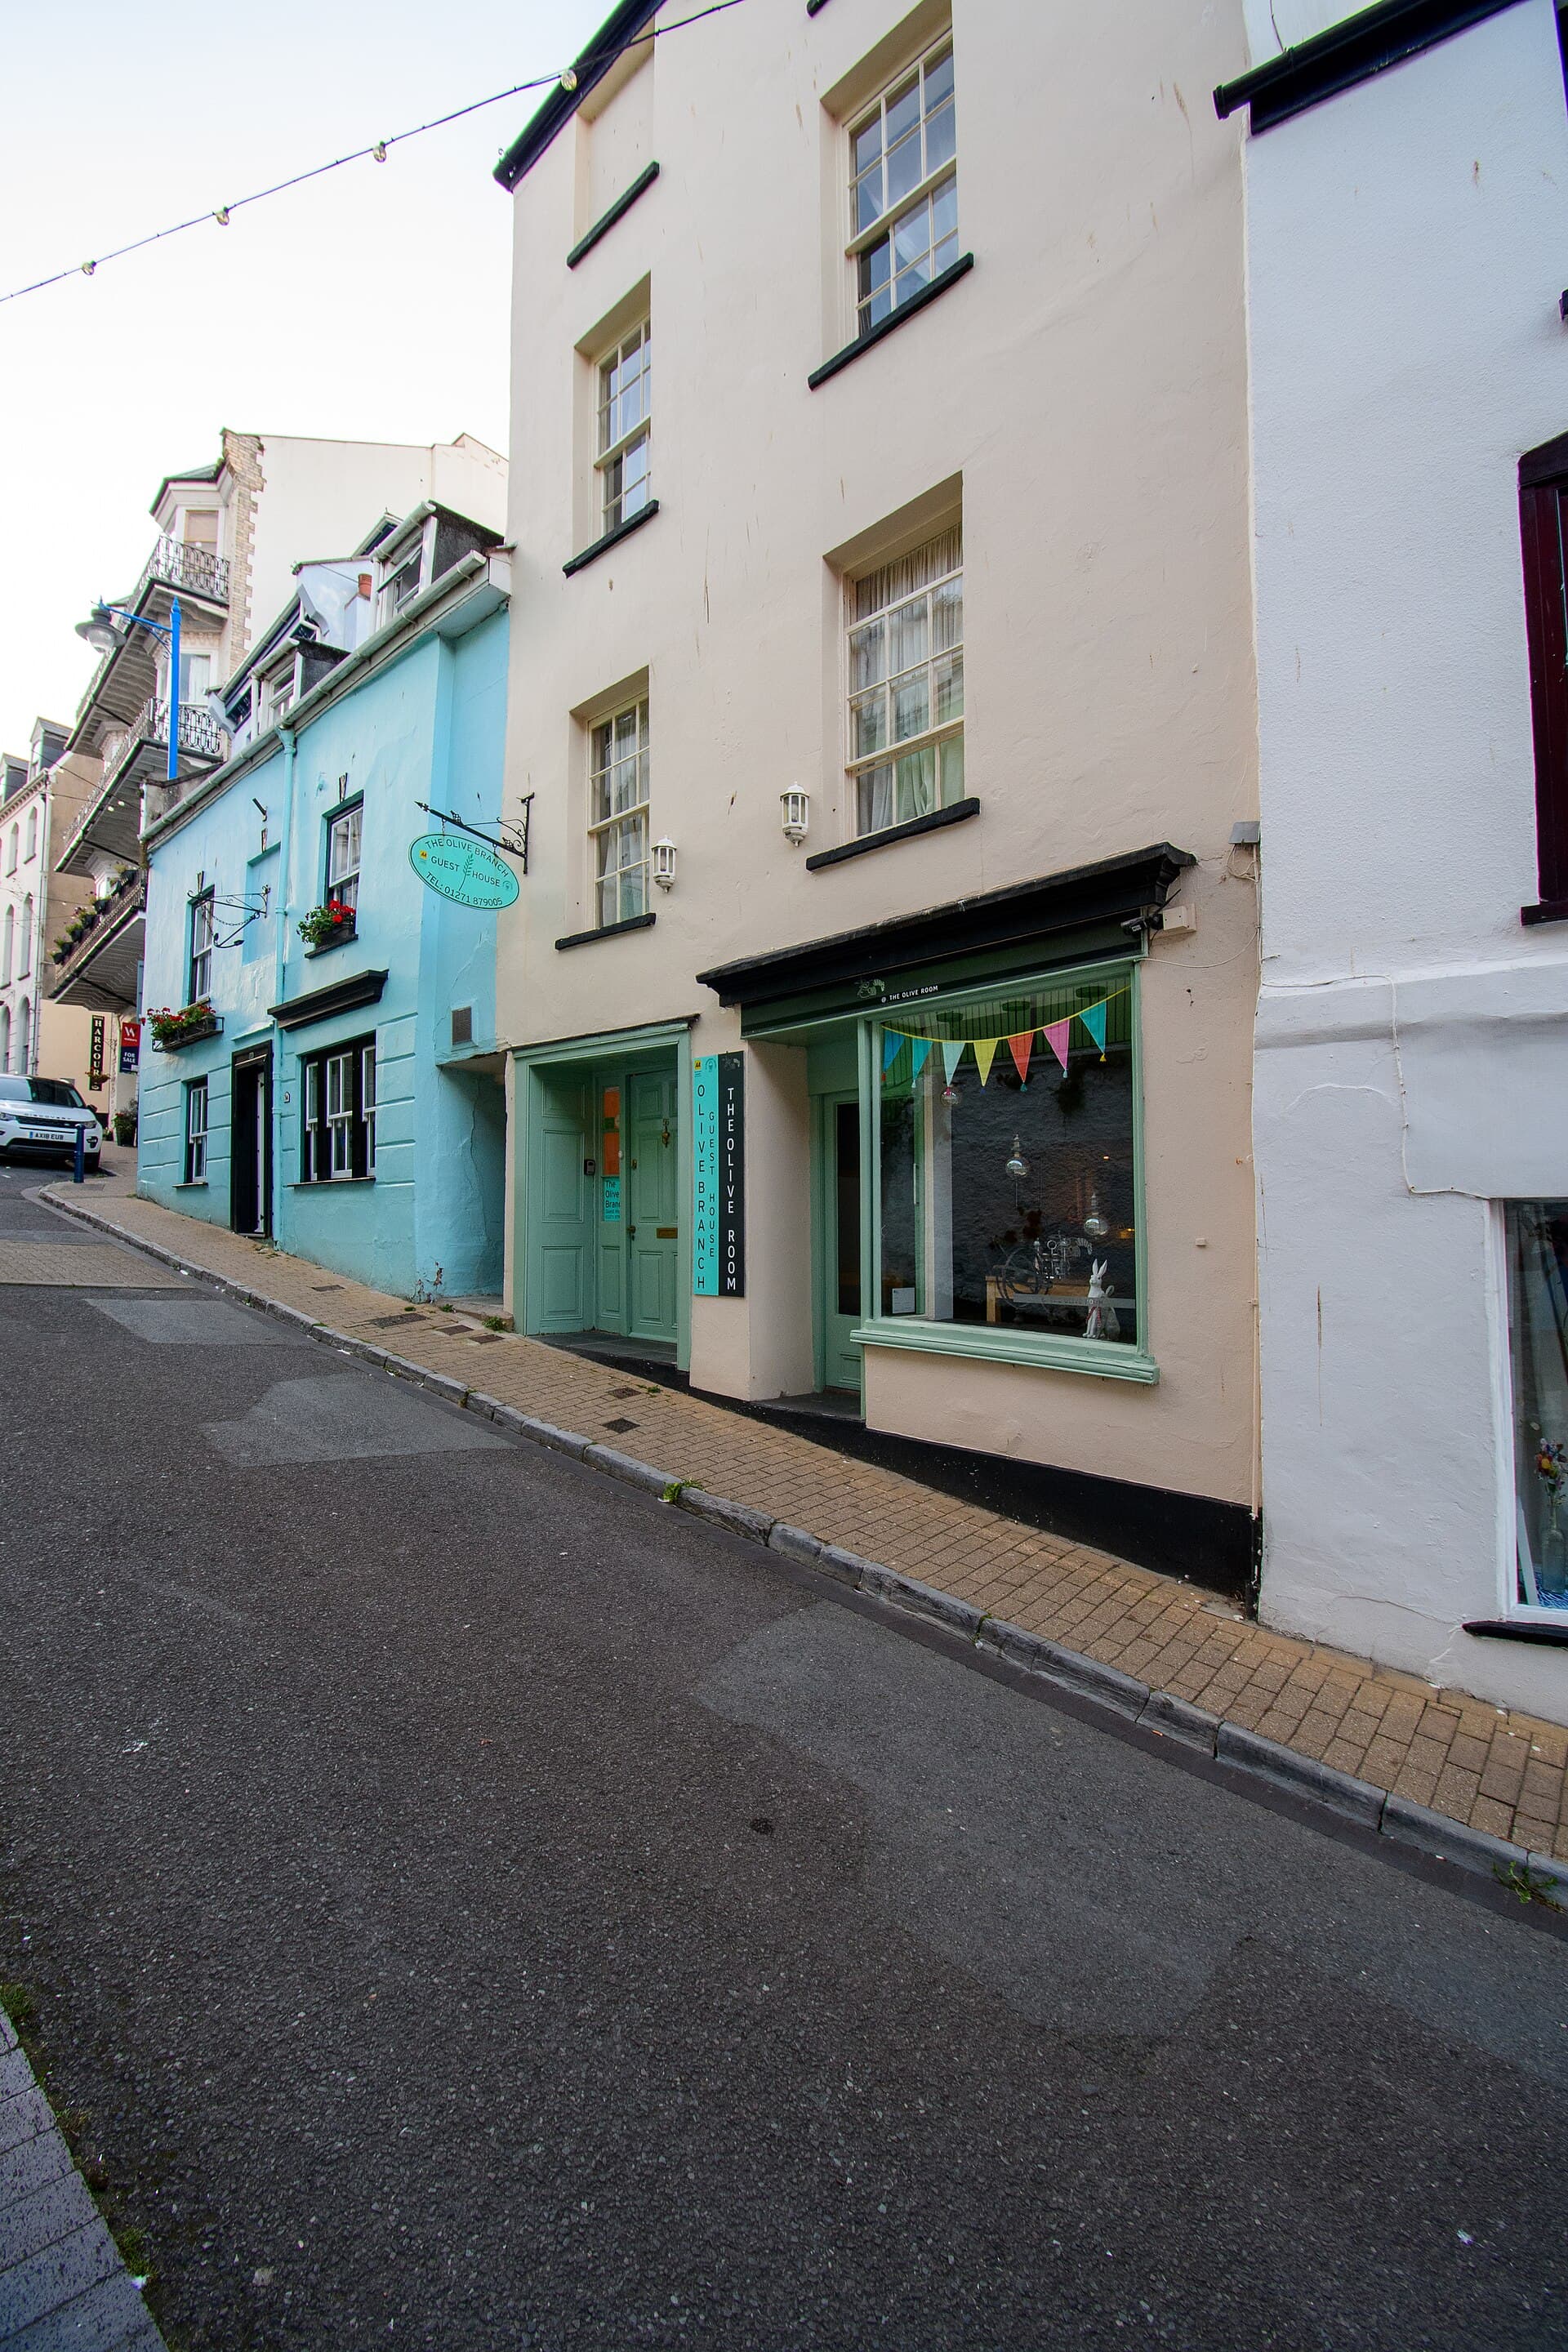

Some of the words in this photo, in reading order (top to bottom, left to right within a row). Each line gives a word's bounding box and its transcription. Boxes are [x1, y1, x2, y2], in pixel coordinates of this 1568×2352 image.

[425, 839, 443, 849] THE
[446, 839, 472, 853] OLIVE
[474, 848, 509, 877] BRANCH
[430, 856, 460, 872] GUEST
[472, 871, 501, 887] HOUSE
[425, 871, 443, 889] TEL:
[444, 886, 470, 902] 01271
[473, 897, 503, 906] 879005
[889, 992, 900, 1000] THE
[902, 989, 919, 998] OLIVE
[920, 985, 938, 994] ROOM
[93, 1019, 102, 1076] HARCOUR
[605, 1190, 620, 1198] Olive
[606, 1180, 616, 1188] The
[727, 1229, 736, 1290] ROOM
